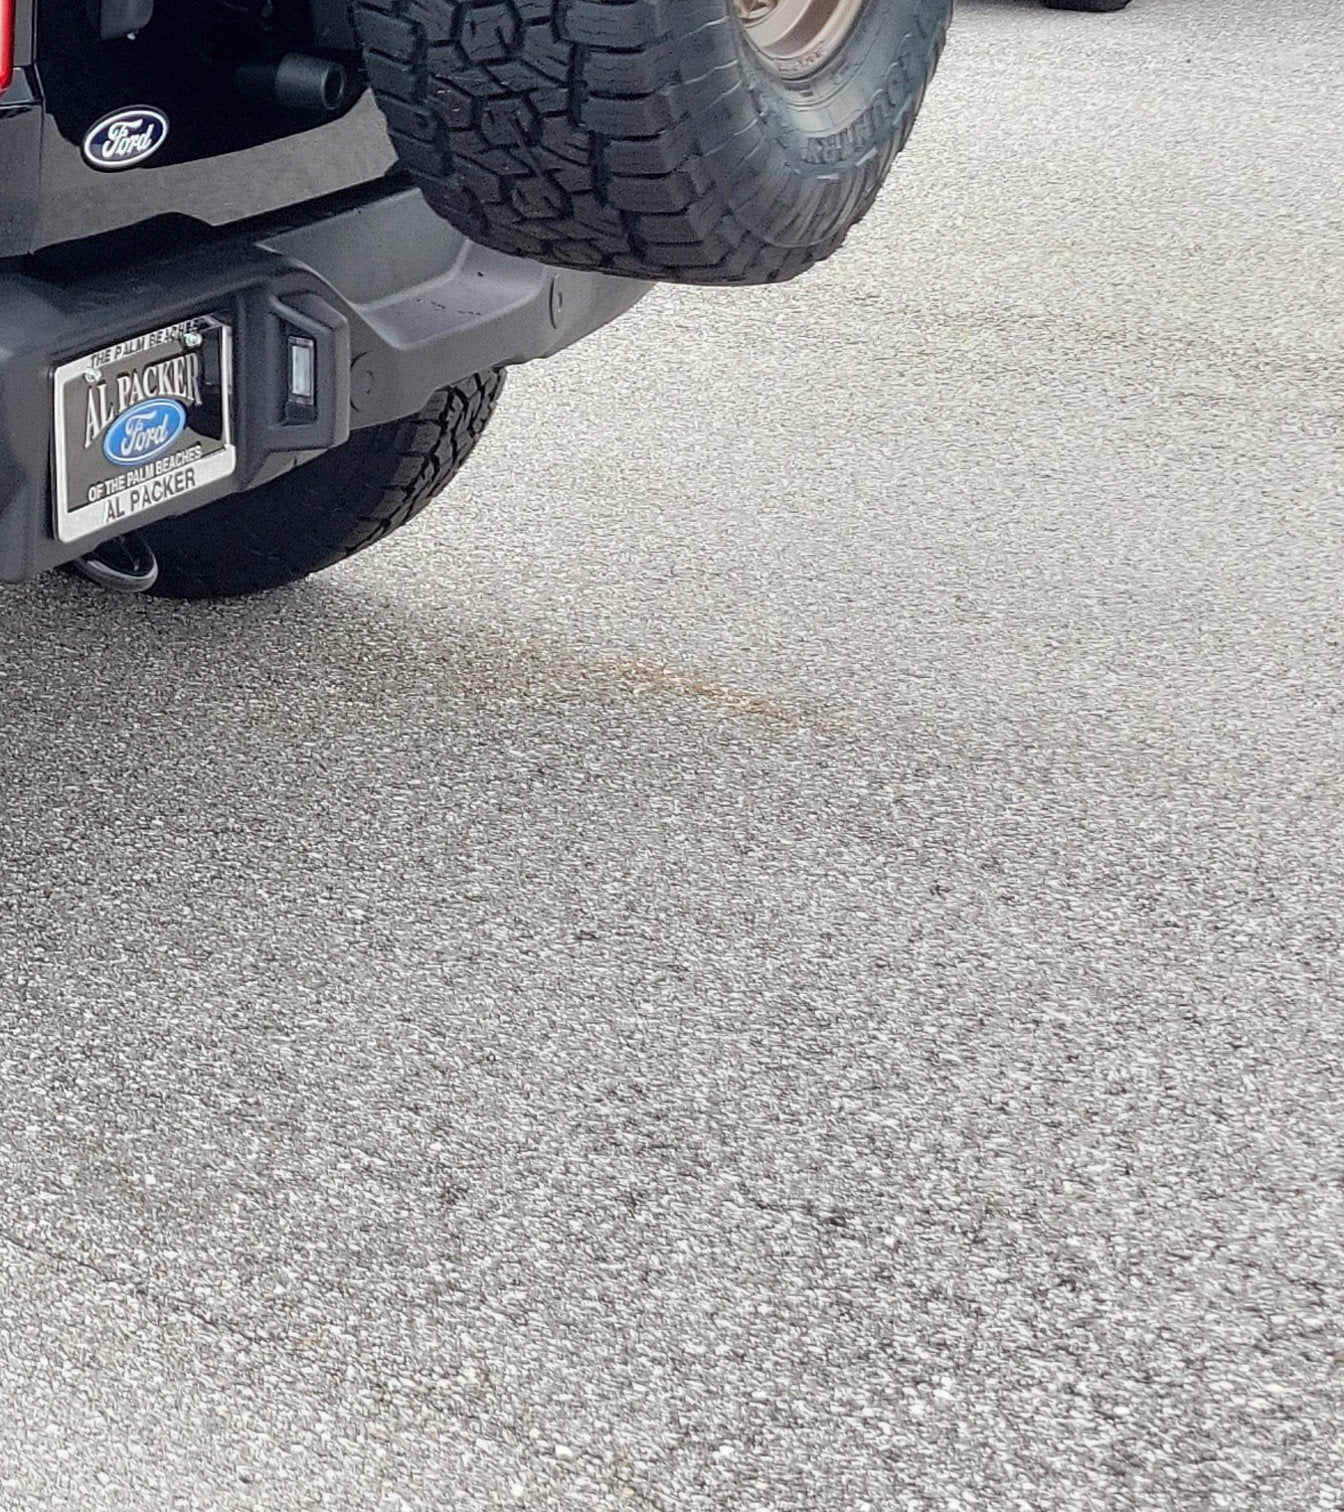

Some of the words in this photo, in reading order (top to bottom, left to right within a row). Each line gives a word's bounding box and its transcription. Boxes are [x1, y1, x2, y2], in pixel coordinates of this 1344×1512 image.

[102, 119, 154, 158] Ford
[90, 345, 112, 366] THE
[115, 336, 146, 360] PALM
[84, 383, 113, 449] AL
[117, 352, 202, 413] PACKER
[121, 410, 169, 456] Ford
[88, 481, 104, 502] OF
[105, 474, 126, 496] THE
[127, 463, 155, 487] PALM
[156, 445, 202, 479] BEACHES
[106, 497, 125, 523] AL
[130, 467, 195, 511] PACKER
